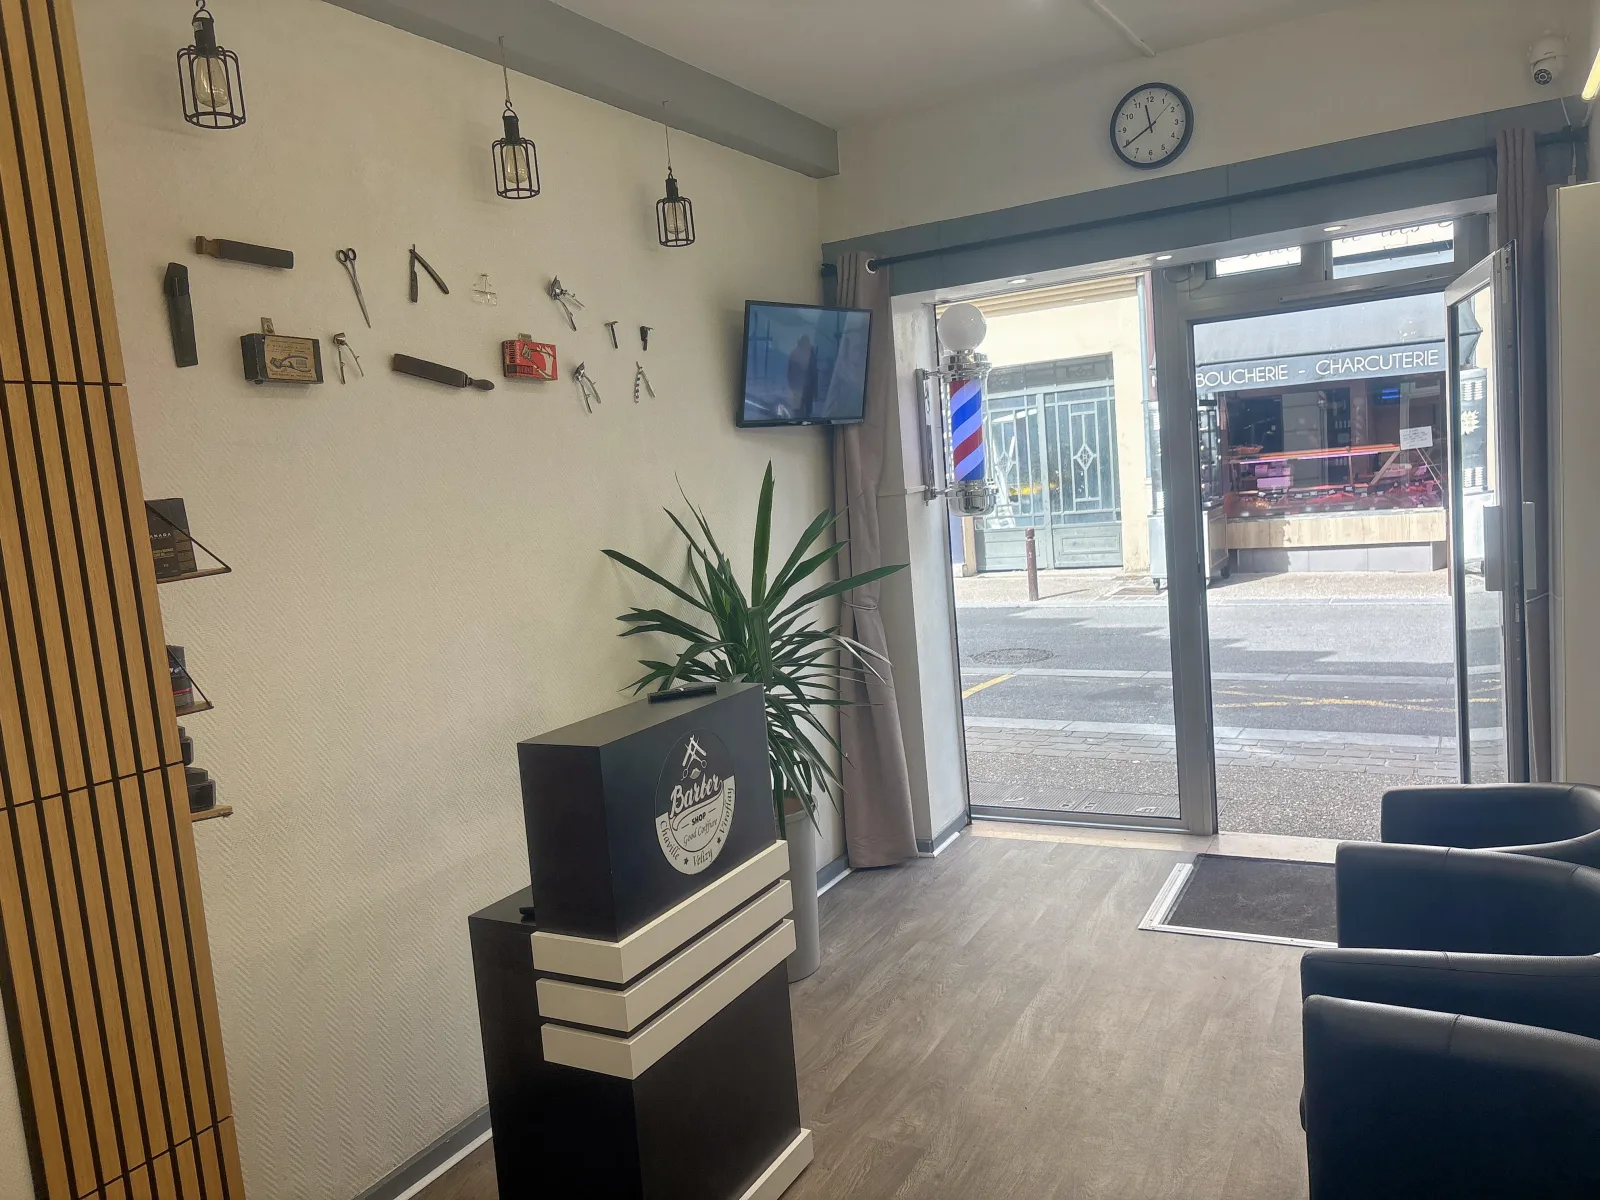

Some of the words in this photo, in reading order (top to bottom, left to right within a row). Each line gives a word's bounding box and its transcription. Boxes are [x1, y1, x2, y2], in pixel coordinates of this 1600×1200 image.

[1196, 365, 1288, 388] BOUCHERIE
[1315, 349, 1439, 375] CHARCUTERIE
[669, 773, 720, 819] Barber
[719, 787, 735, 834] Viroflay
[683, 827, 698, 847] Good
[691, 812, 707, 825] SHOP
[660, 820, 680, 861] Chaville
